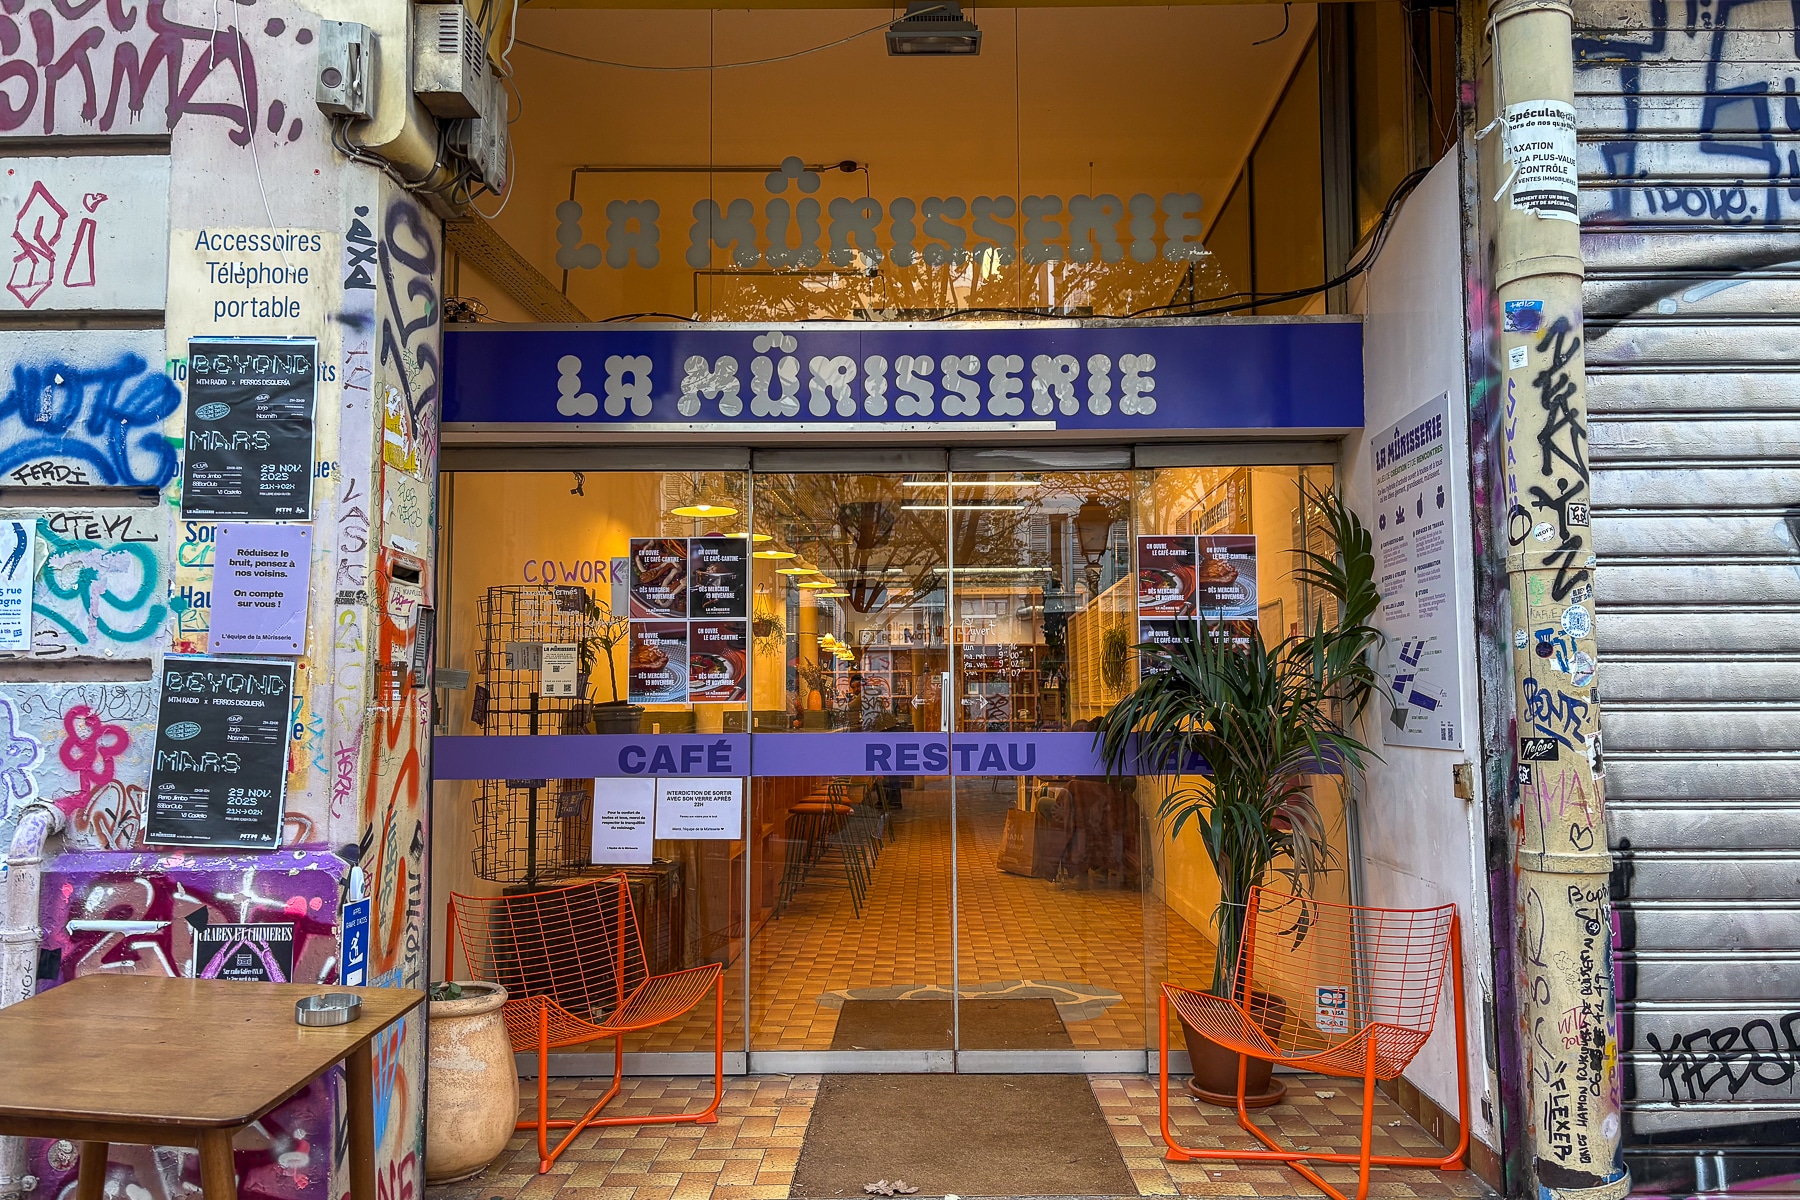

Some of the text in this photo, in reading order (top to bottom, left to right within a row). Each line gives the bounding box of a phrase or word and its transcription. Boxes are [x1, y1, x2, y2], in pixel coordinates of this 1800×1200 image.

[1521, 164, 1568, 175] CONTRÔLE
[1532, 154, 1576, 166] PLUS-VALUE
[556, 157, 1205, 270] LA MÛRISSERIE
[195, 229, 321, 252] Accessoires
[206, 262, 309, 287] Téléphone
[214, 296, 301, 322] portable
[193, 355, 312, 375] BEYOND
[557, 331, 1158, 417] LA MÛRISSERIE
[189, 431, 271, 451] MARS
[1376, 413, 1442, 472] LA MÛRISSERIE
[260, 464, 302, 472] 29 NOV.
[260, 473, 289, 481] 2025
[237, 549, 289, 558] Réduisez le
[229, 559, 296, 569] bruit, pensez à
[523, 559, 625, 584] COWORK
[254, 570, 288, 578] voisins.
[234, 589, 284, 599] On compte
[962, 618, 996, 636] Ouvert
[166, 671, 287, 696] BEYOND
[212, 698, 235, 706] PERROS
[157, 750, 242, 774] MARS
[618, 739, 732, 774] CAFÉ
[865, 742, 1036, 772] RESTAU
[227, 797, 258, 806] 2025
[228, 788, 273, 798] 29 NOV.
[234, 927, 247, 942] ET
